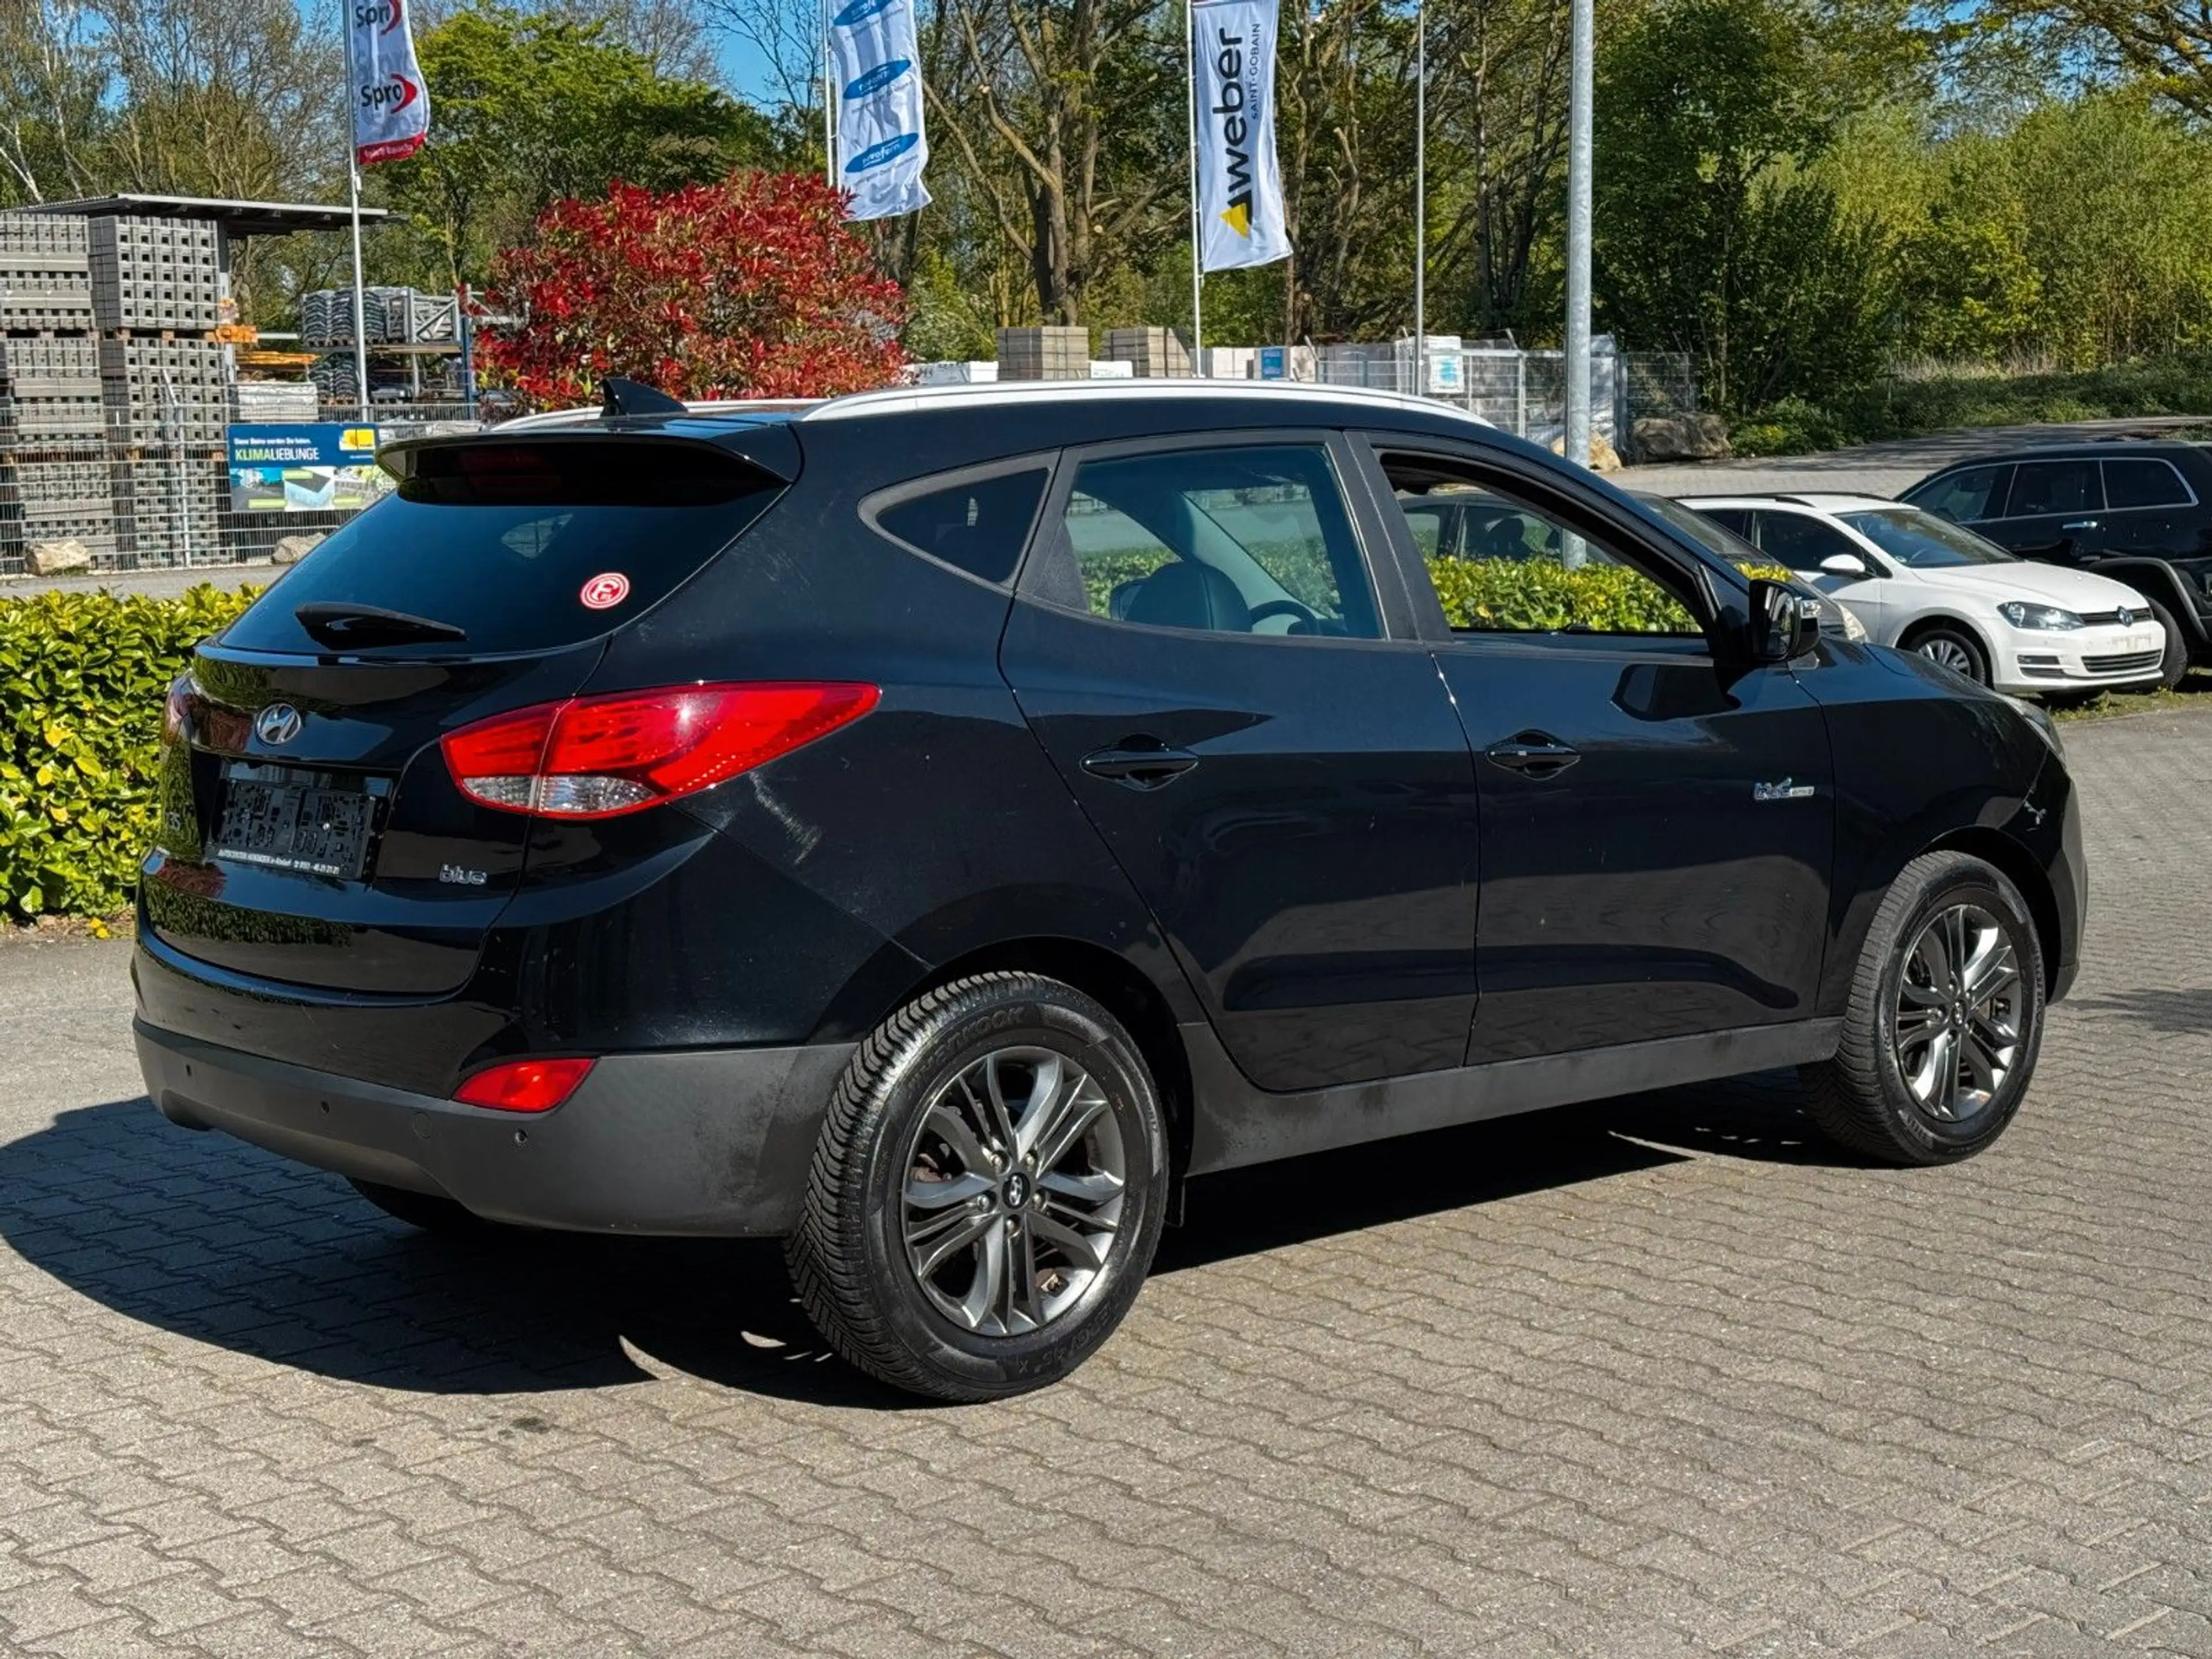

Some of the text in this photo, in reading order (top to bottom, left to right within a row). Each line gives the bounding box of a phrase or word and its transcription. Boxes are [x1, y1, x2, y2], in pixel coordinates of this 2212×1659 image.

[361, 84, 402, 109] Spro
[1249, 23, 1261, 120] SAINT-GOBAIN
[1213, 28, 1252, 192] weber
[234, 448, 320, 461] KLIMALIEBLINGE
